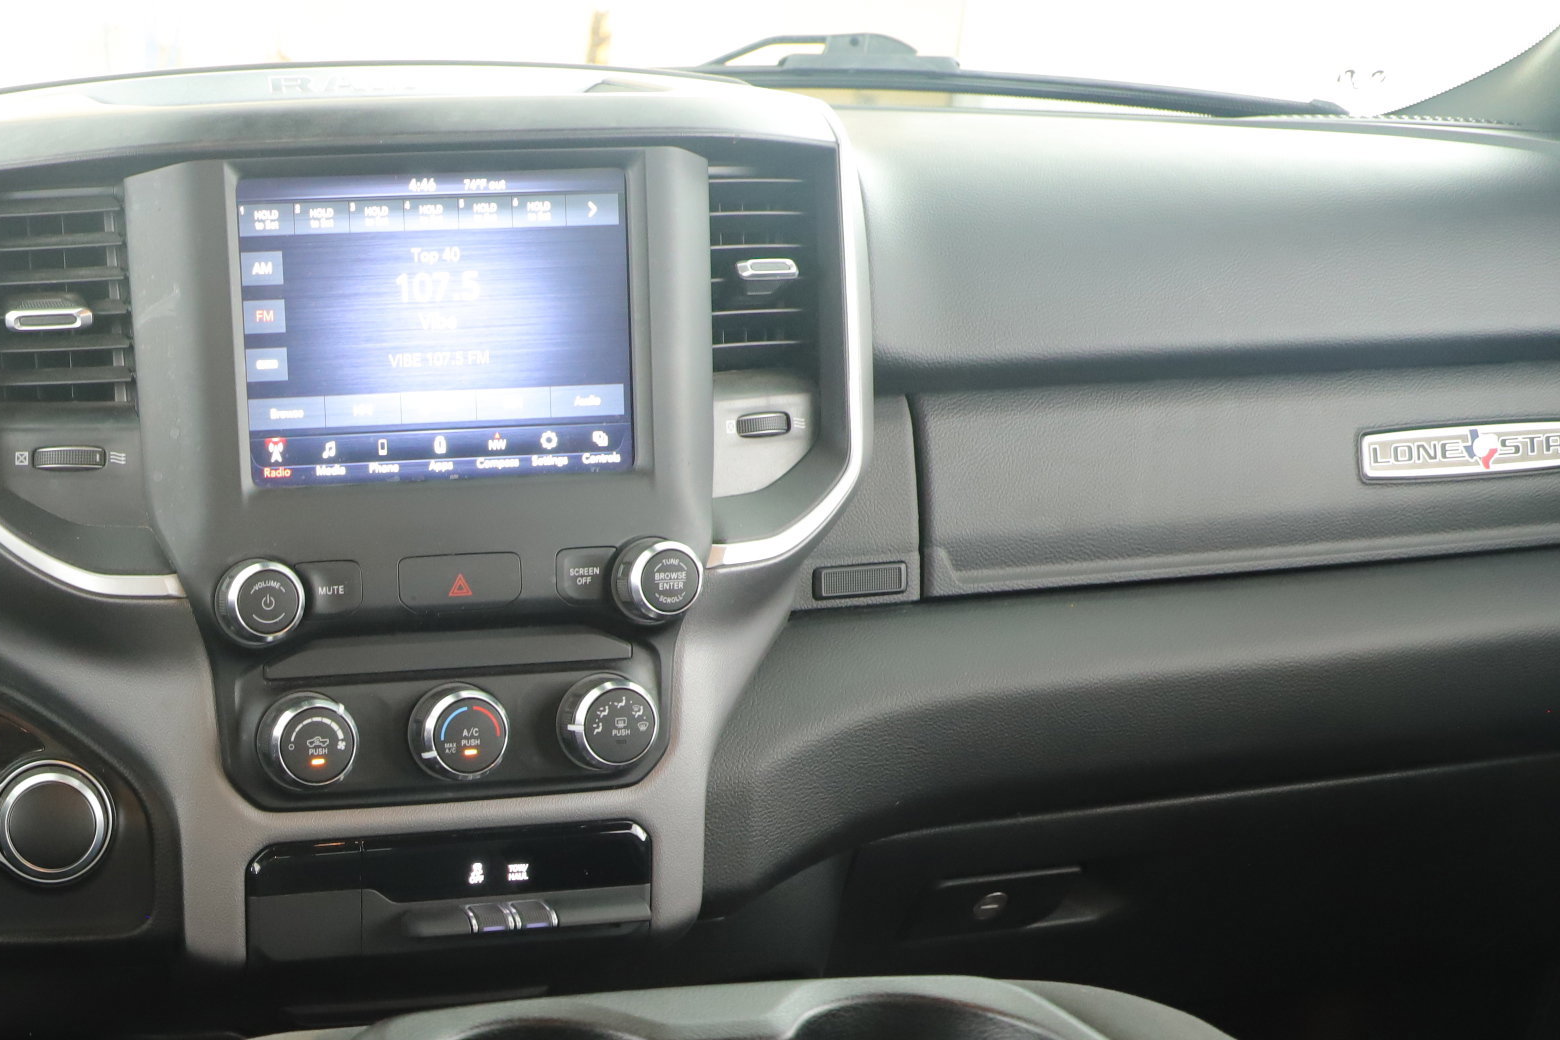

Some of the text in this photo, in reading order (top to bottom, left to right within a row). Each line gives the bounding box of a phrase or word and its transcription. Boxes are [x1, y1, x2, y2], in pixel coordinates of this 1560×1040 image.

[409, 178, 437, 192] 4:46
[410, 246, 460, 265] Top 40
[252, 262, 273, 275] AM
[396, 270, 480, 303] 107.5
[256, 310, 274, 323] FM
[388, 350, 490, 368] VIBE 107.5 FM
[488, 439, 507, 451] NW
[582, 451, 621, 464] Controls
[1369, 441, 1465, 466] LONE
[476, 457, 520, 469] Compass
[531, 454, 569, 467] Settings
[263, 467, 292, 479] Radio
[316, 465, 346, 477] Media
[369, 462, 400, 474] Phone
[428, 461, 454, 473] Apps
[662, 558, 680, 566] TUNE
[569, 567, 600, 576] SCREEN
[654, 571, 687, 580] BROWSE
[254, 580, 281, 591] VOLUME
[576, 577, 592, 585] OFF
[659, 582, 684, 591] ENTER
[318, 585, 345, 595] MUTE
[659, 595, 683, 604] SCROLL
[462, 727, 480, 737] A/C
[612, 728, 631, 737] PUSH
[461, 739, 481, 747] PUSH
[308, 748, 328, 756] PUSH
[469, 874, 485, 884] OFF
[508, 872, 529, 881] HAUL
